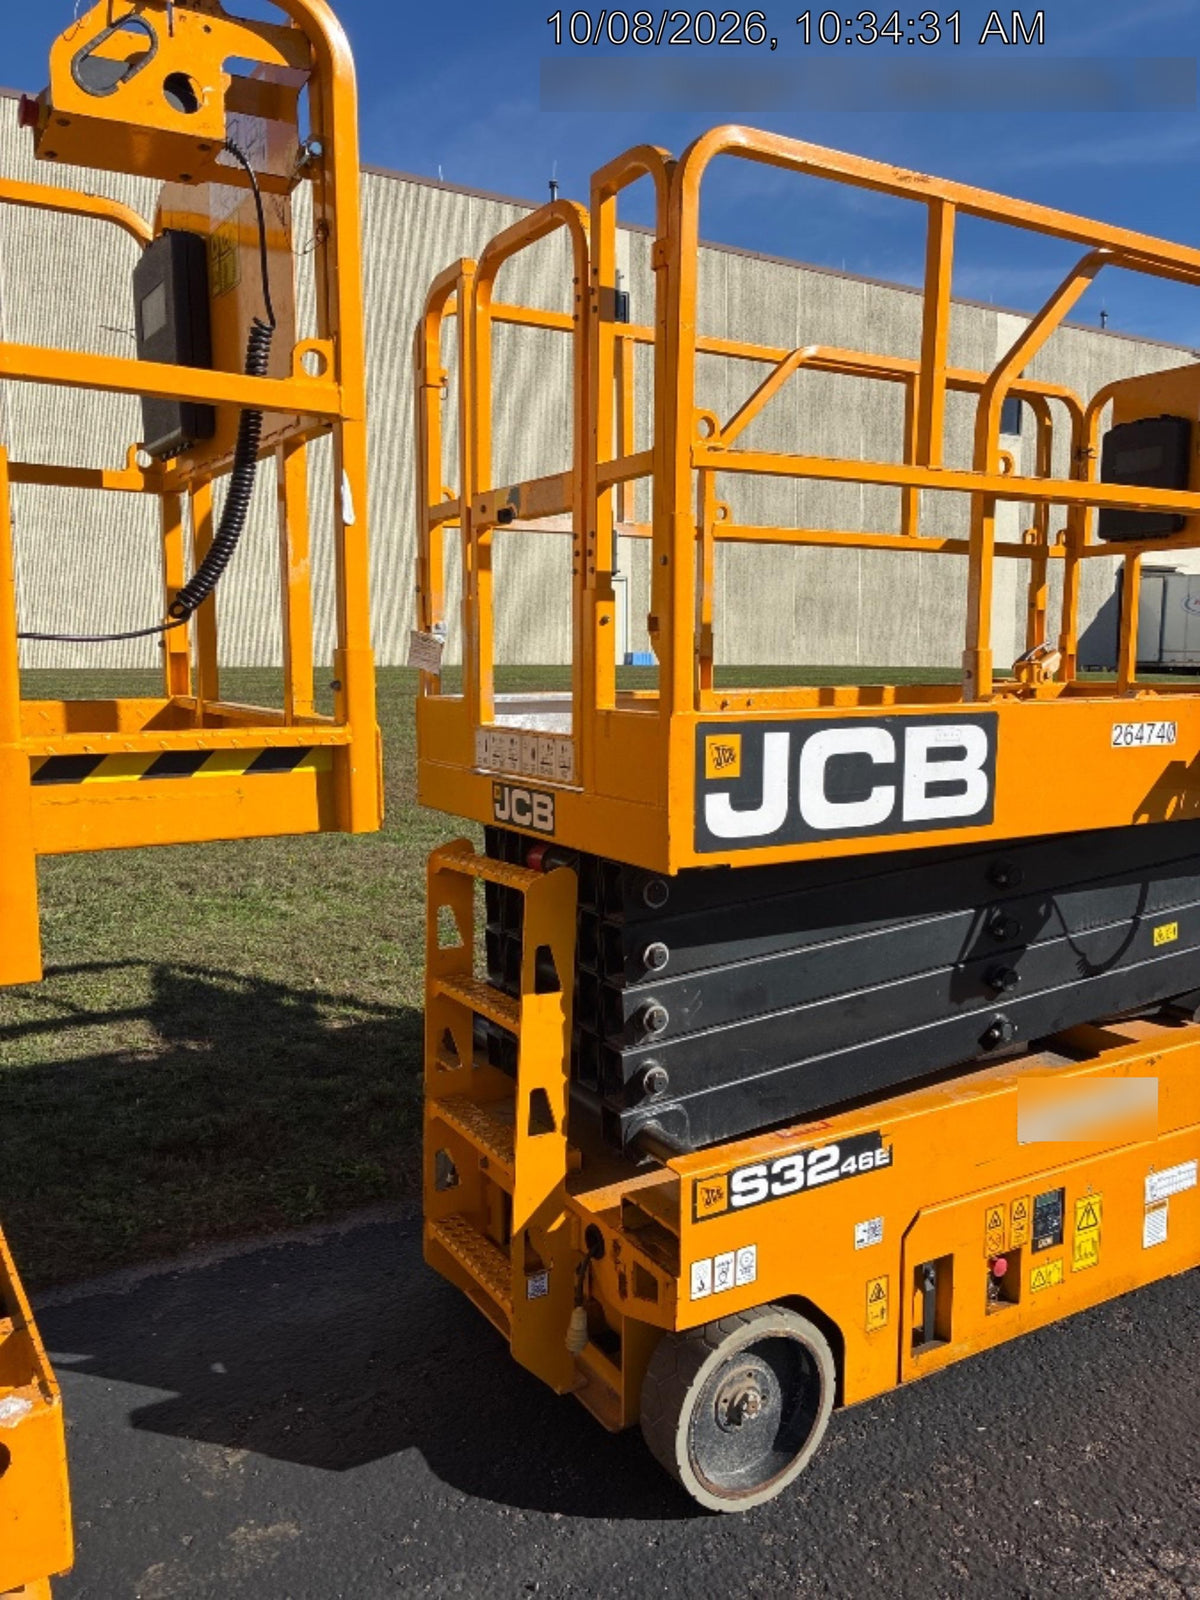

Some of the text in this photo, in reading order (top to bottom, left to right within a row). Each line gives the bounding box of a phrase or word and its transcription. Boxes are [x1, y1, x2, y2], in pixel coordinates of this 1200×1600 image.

[1113, 723, 1176, 745] 264740
[705, 725, 988, 838] JCB
[495, 787, 554, 831] JCB
